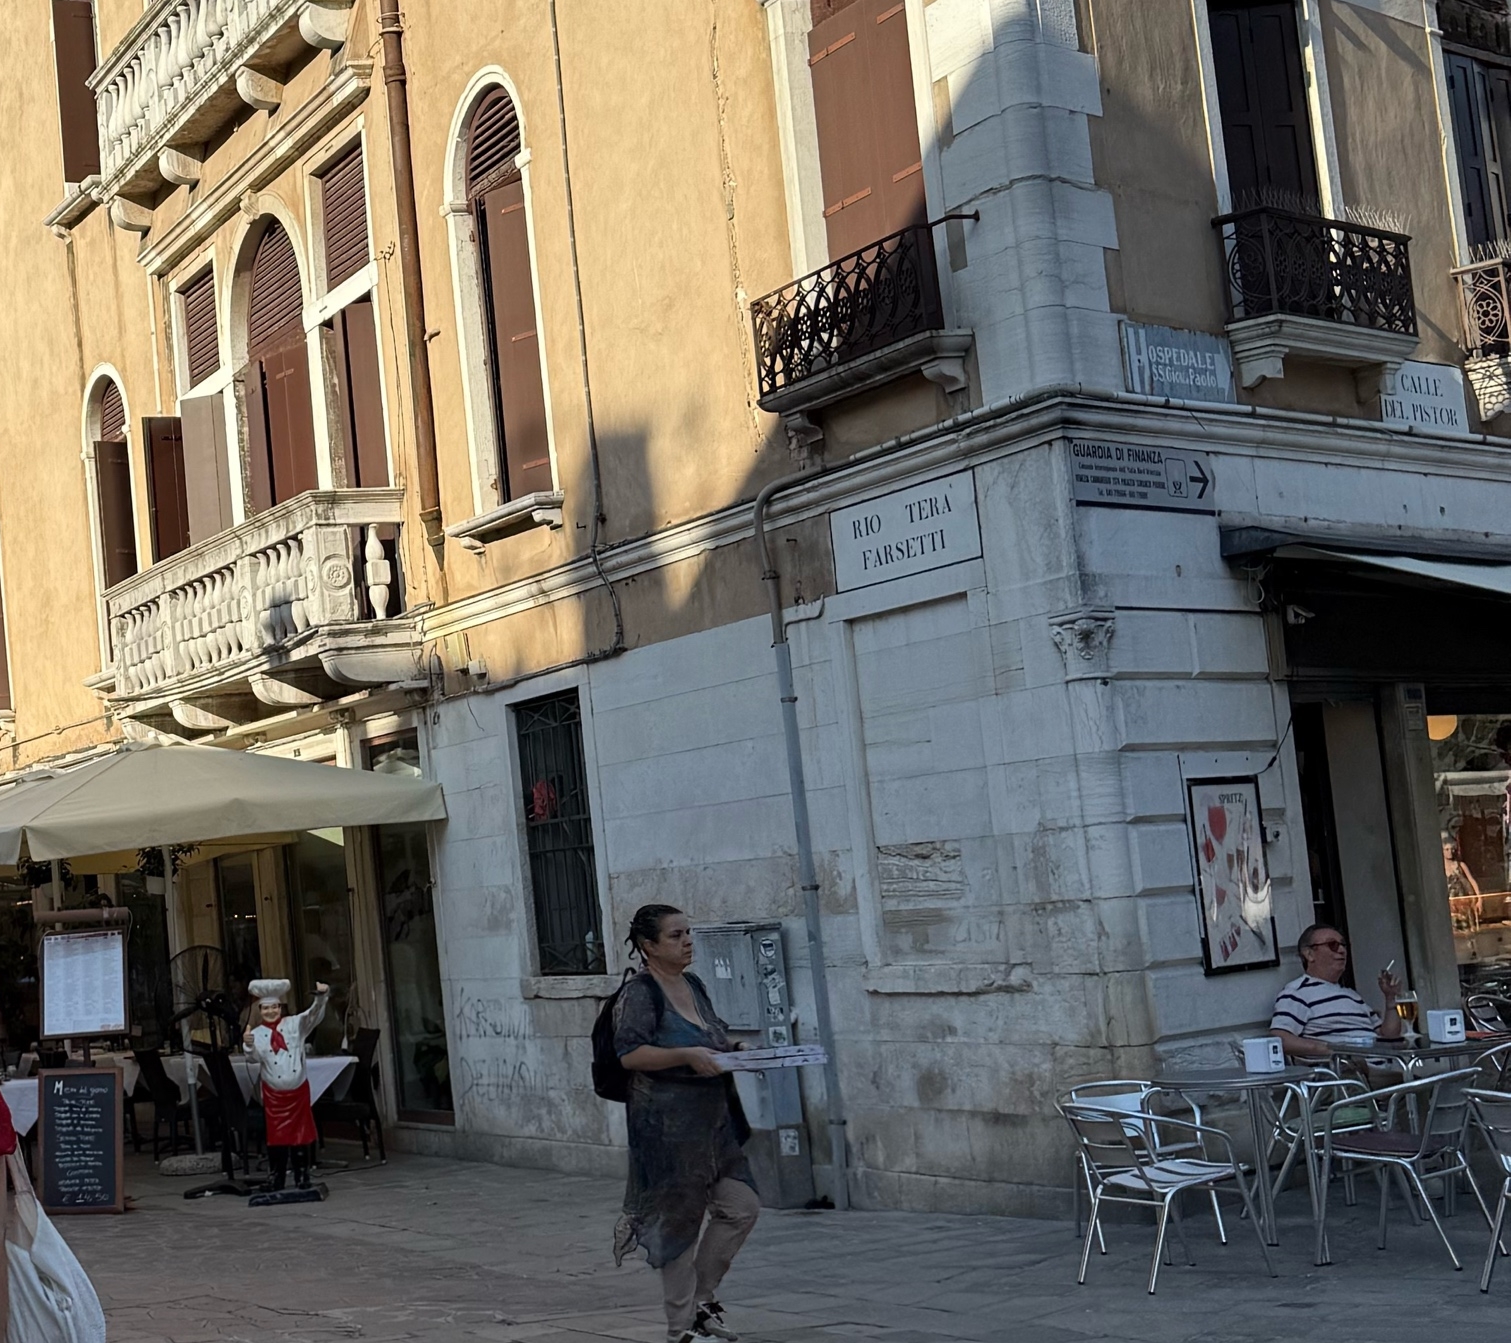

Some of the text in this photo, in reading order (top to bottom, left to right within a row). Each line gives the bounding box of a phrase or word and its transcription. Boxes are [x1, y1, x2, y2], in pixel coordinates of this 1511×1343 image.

[1400, 373, 1444, 397] CALLE
[1384, 398, 1459, 427] DEL PISTOR
[1072, 443, 1164, 464] GUARDIA DI FINANZA
[852, 514, 882, 540] RIO
[862, 529, 946, 570] FARSETTI
